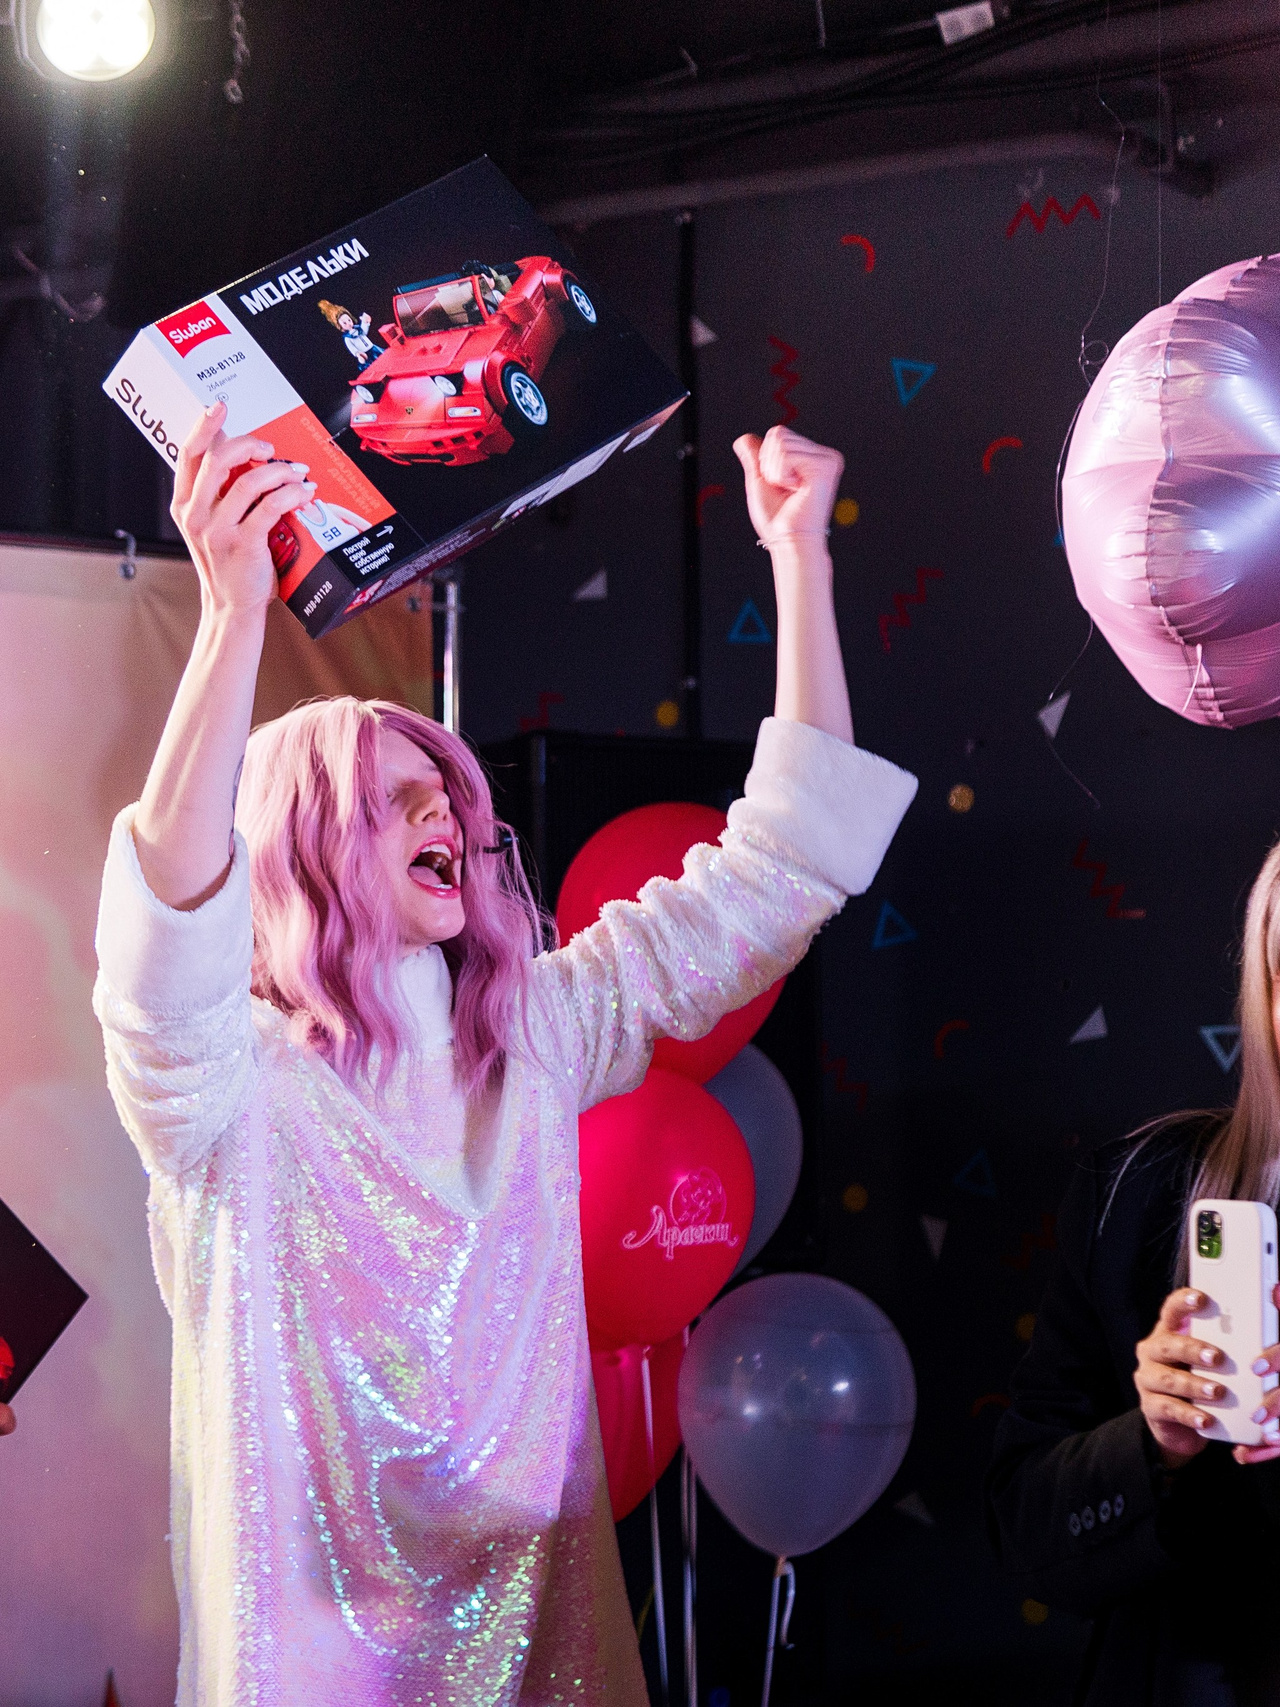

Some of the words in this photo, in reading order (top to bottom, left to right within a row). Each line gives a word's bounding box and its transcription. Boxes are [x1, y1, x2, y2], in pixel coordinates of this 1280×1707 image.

[239, 237, 370, 316] МОДЕЛЬКИ
[168, 315, 217, 345] Sluban
[196, 351, 246, 381] M38-B1128
[115, 378, 180, 463] Sluba
[342, 536, 371, 556] Построй
[348, 548, 367, 563] свою
[354, 542, 395, 569] собственную
[359, 553, 391, 576] историю!
